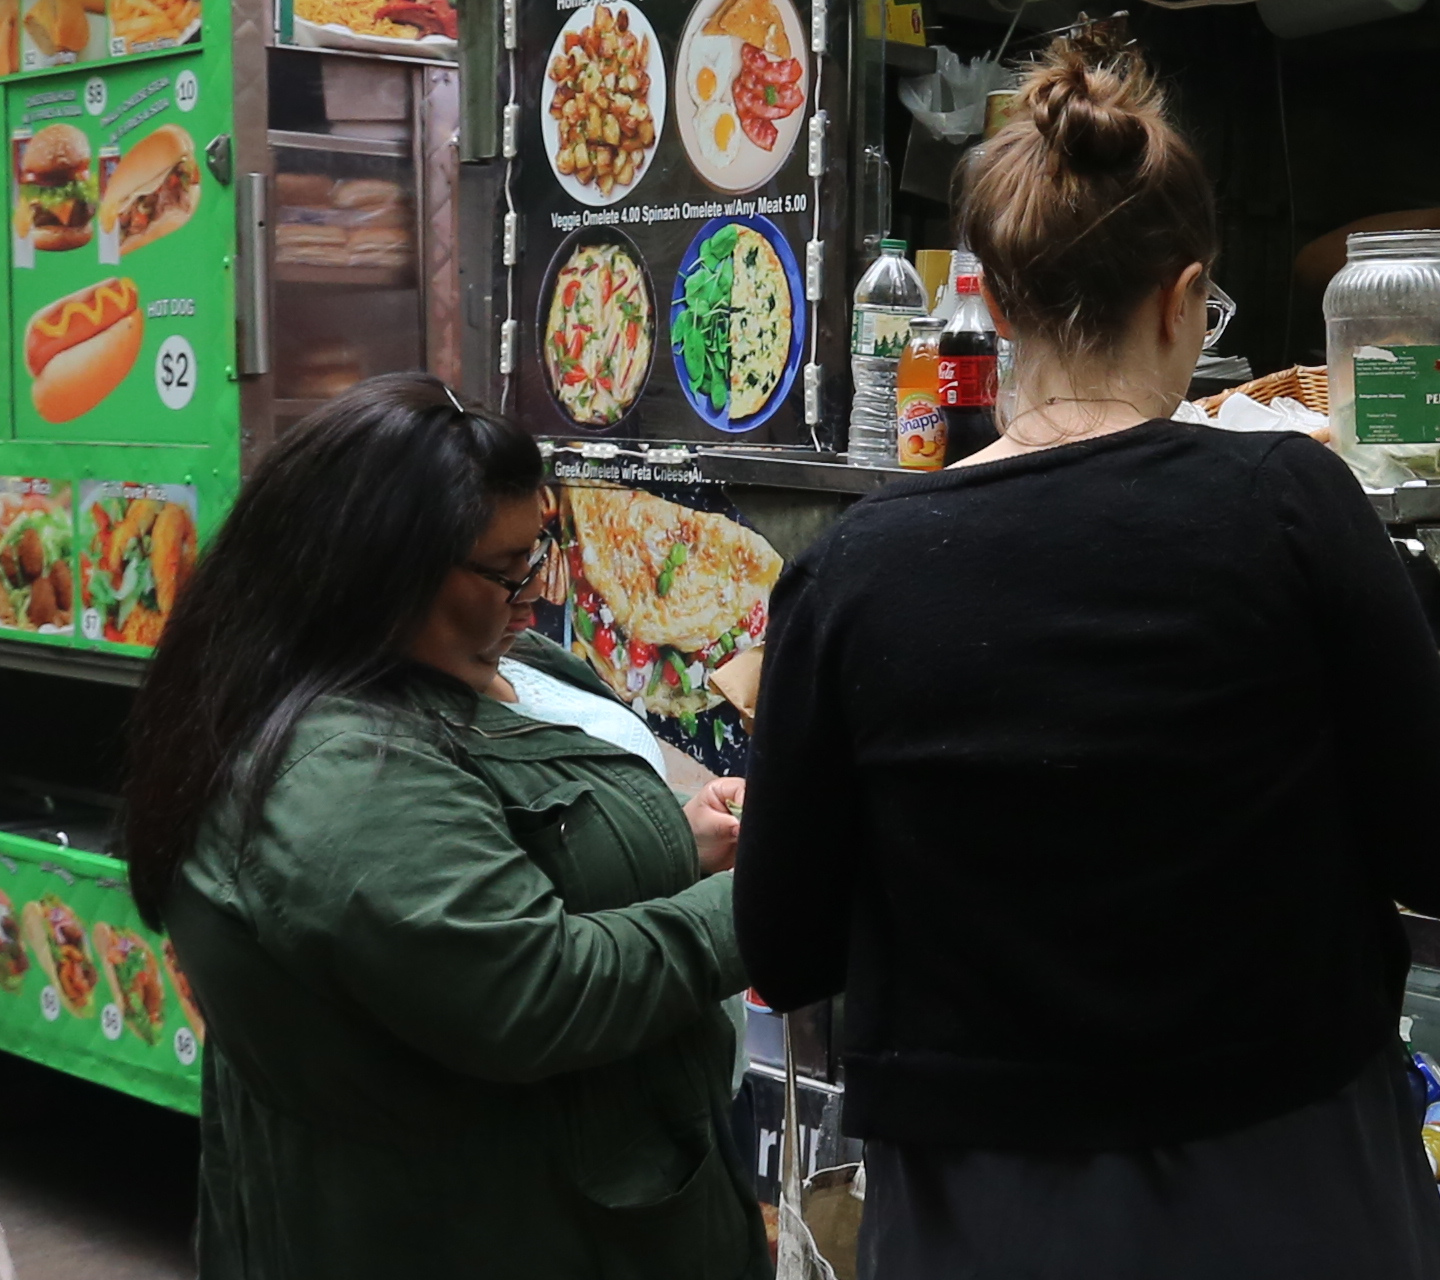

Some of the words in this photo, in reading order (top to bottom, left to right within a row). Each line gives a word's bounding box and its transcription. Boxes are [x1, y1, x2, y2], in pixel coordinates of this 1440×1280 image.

[178, 82, 195, 101] 10
[148, 299, 169, 318] HOT
[170, 298, 196, 316] DOG
[161, 349, 189, 390] $2
